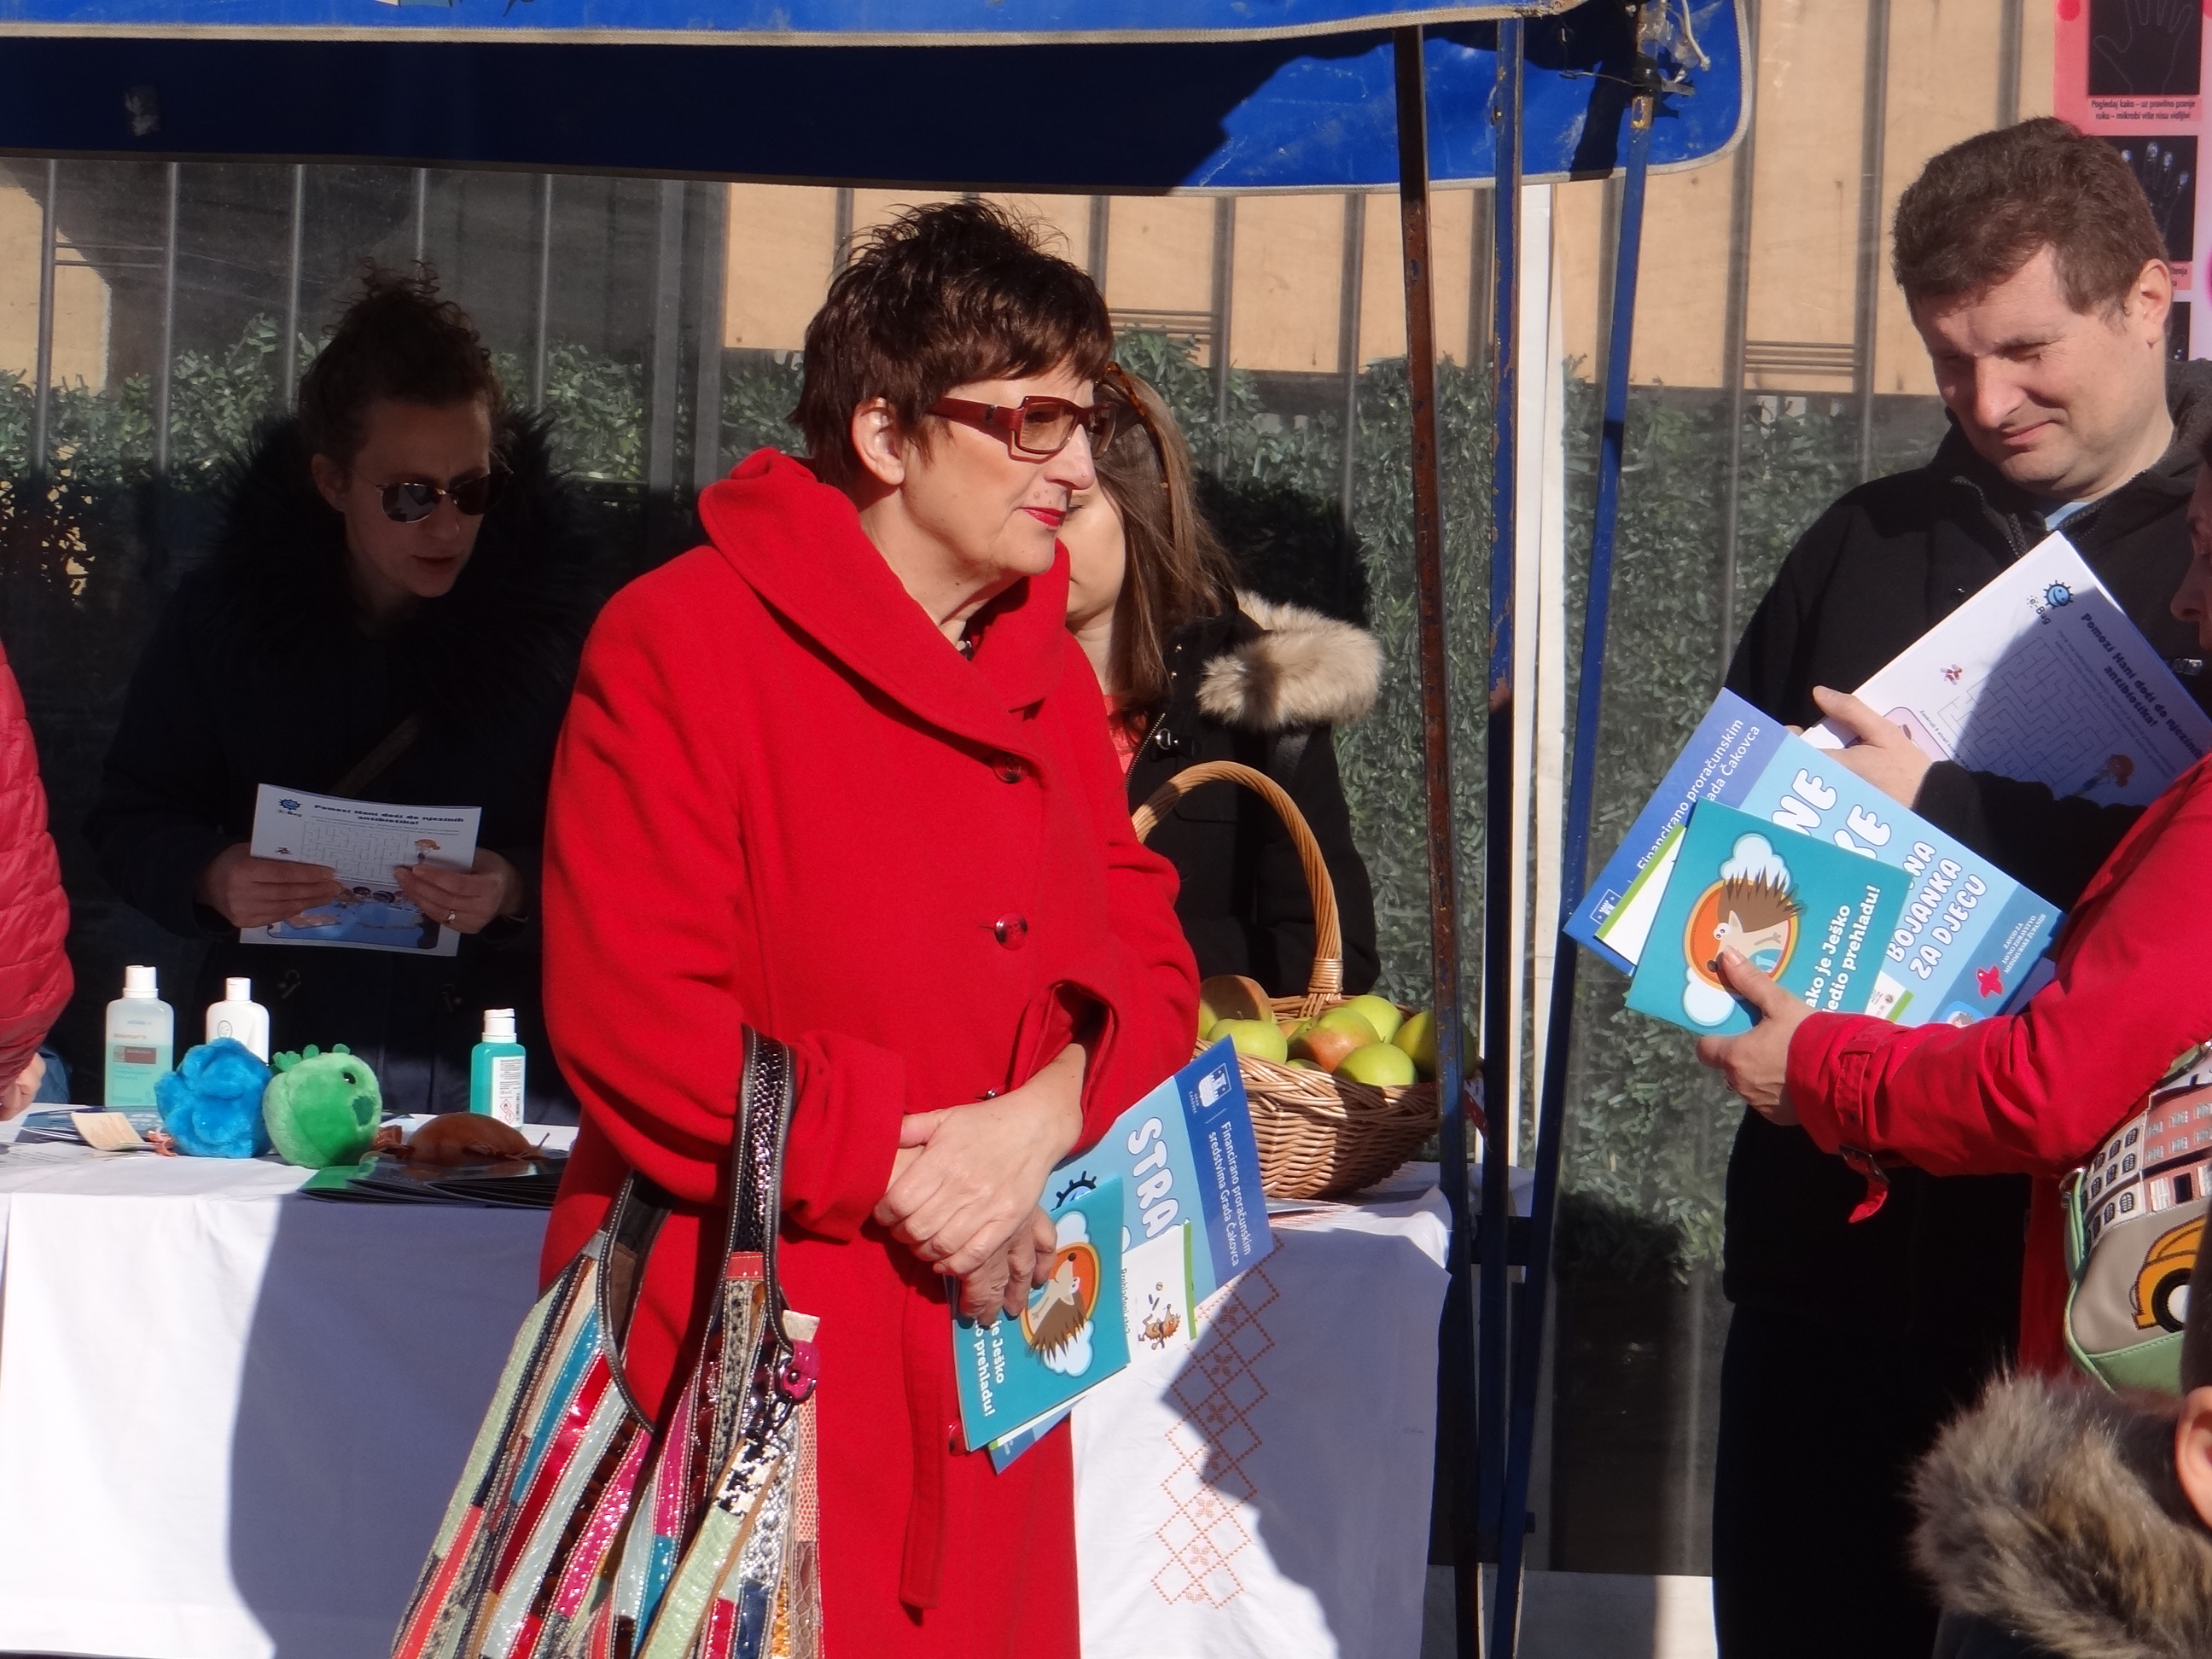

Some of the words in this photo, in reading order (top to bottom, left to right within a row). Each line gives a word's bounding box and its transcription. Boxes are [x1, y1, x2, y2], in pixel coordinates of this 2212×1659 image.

[2081, 611, 2115, 652] Pomozi
[2111, 651, 2137, 679] Hani
[2152, 701, 2169, 719] do
[1720, 725, 1761, 777] Čakovca
[1636, 801, 1690, 870] Financirano
[1687, 719, 1743, 801] proračunskim
[1842, 885, 1880, 969] prehladu!
[1885, 858, 1963, 963] BOJANKA
[1908, 945, 1941, 980] ZA
[1930, 874, 1987, 946] DJECU
[2001, 945, 2016, 963] JAVNO
[2012, 914, 2036, 947] ZDRAVSTVO
[2003, 929, 2017, 949] ZAVOD
[2015, 922, 2023, 930] ZA
[1804, 975, 1825, 1006] ako
[1815, 956, 1831, 976] je
[1823, 904, 1851, 954] Ješko
[1126, 1115, 1190, 1240] STRA
[1208, 1132, 1225, 1188] sredstvima
[1220, 1121, 1240, 1184] Financirano
[1231, 1185, 1252, 1254] proračunskim
[1220, 1189, 1232, 1221] Grada
[1225, 1222, 1238, 1266] Čakovca
[974, 1338, 995, 1416] prehladu!
[993, 1337, 1004, 1382] Ješko
